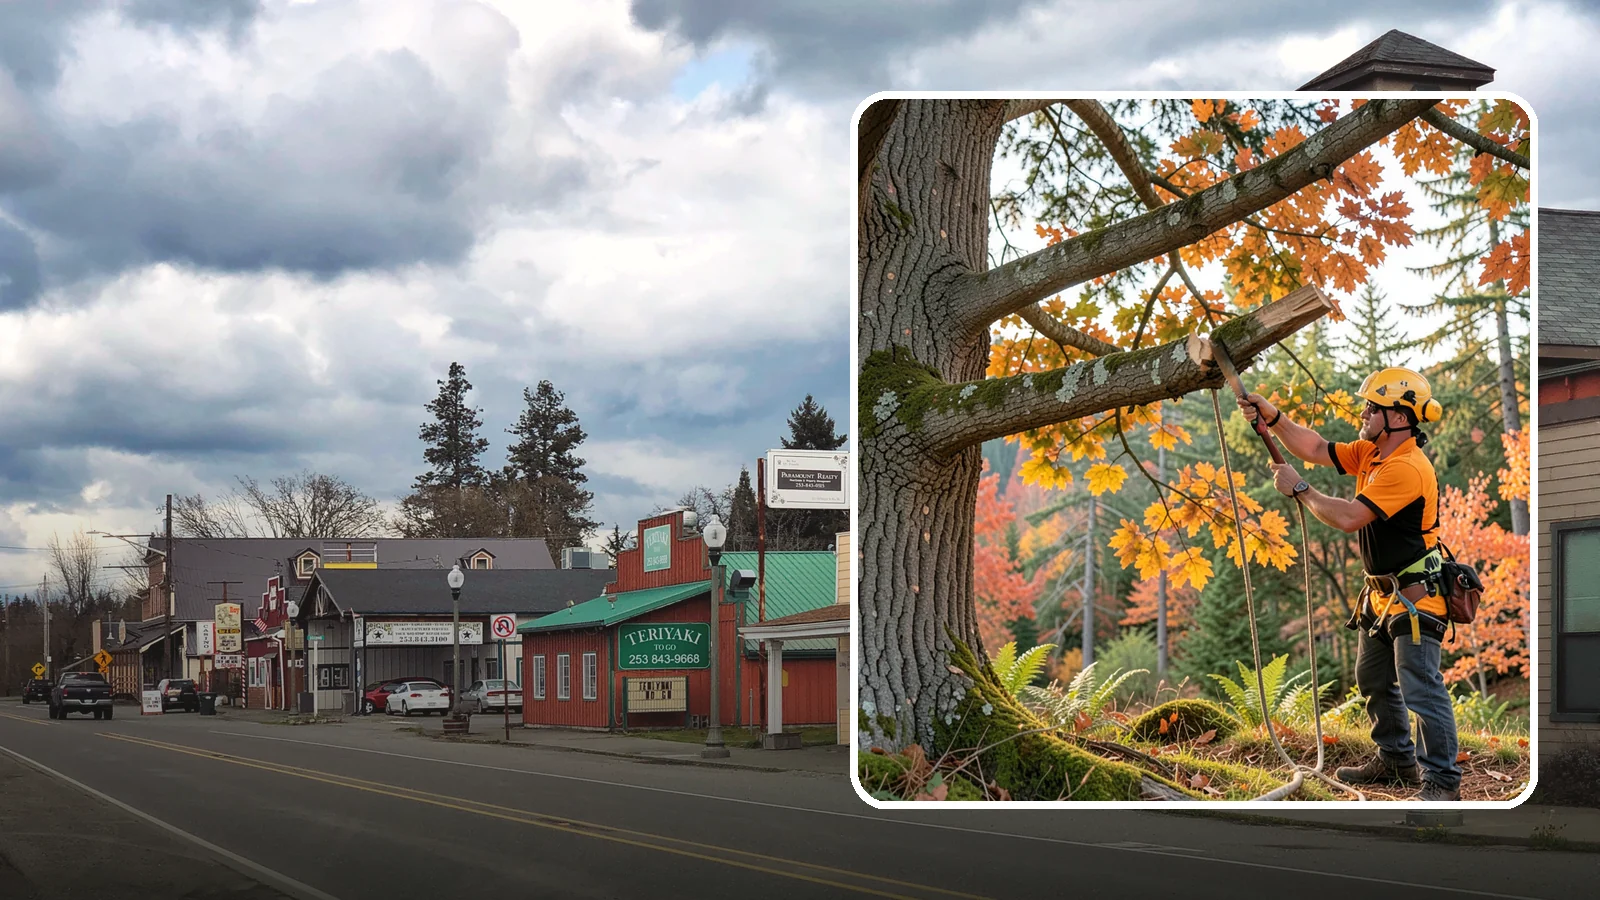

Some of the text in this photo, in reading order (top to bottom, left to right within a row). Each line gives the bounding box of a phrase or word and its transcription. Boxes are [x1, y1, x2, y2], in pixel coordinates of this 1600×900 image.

[781, 471, 839, 480] PARAMOUNT REALTY
[624, 627, 703, 645] TERIYAKI
[628, 653, 700, 665] 253 843-9668
[639, 681, 673, 691] TERIYAKI
